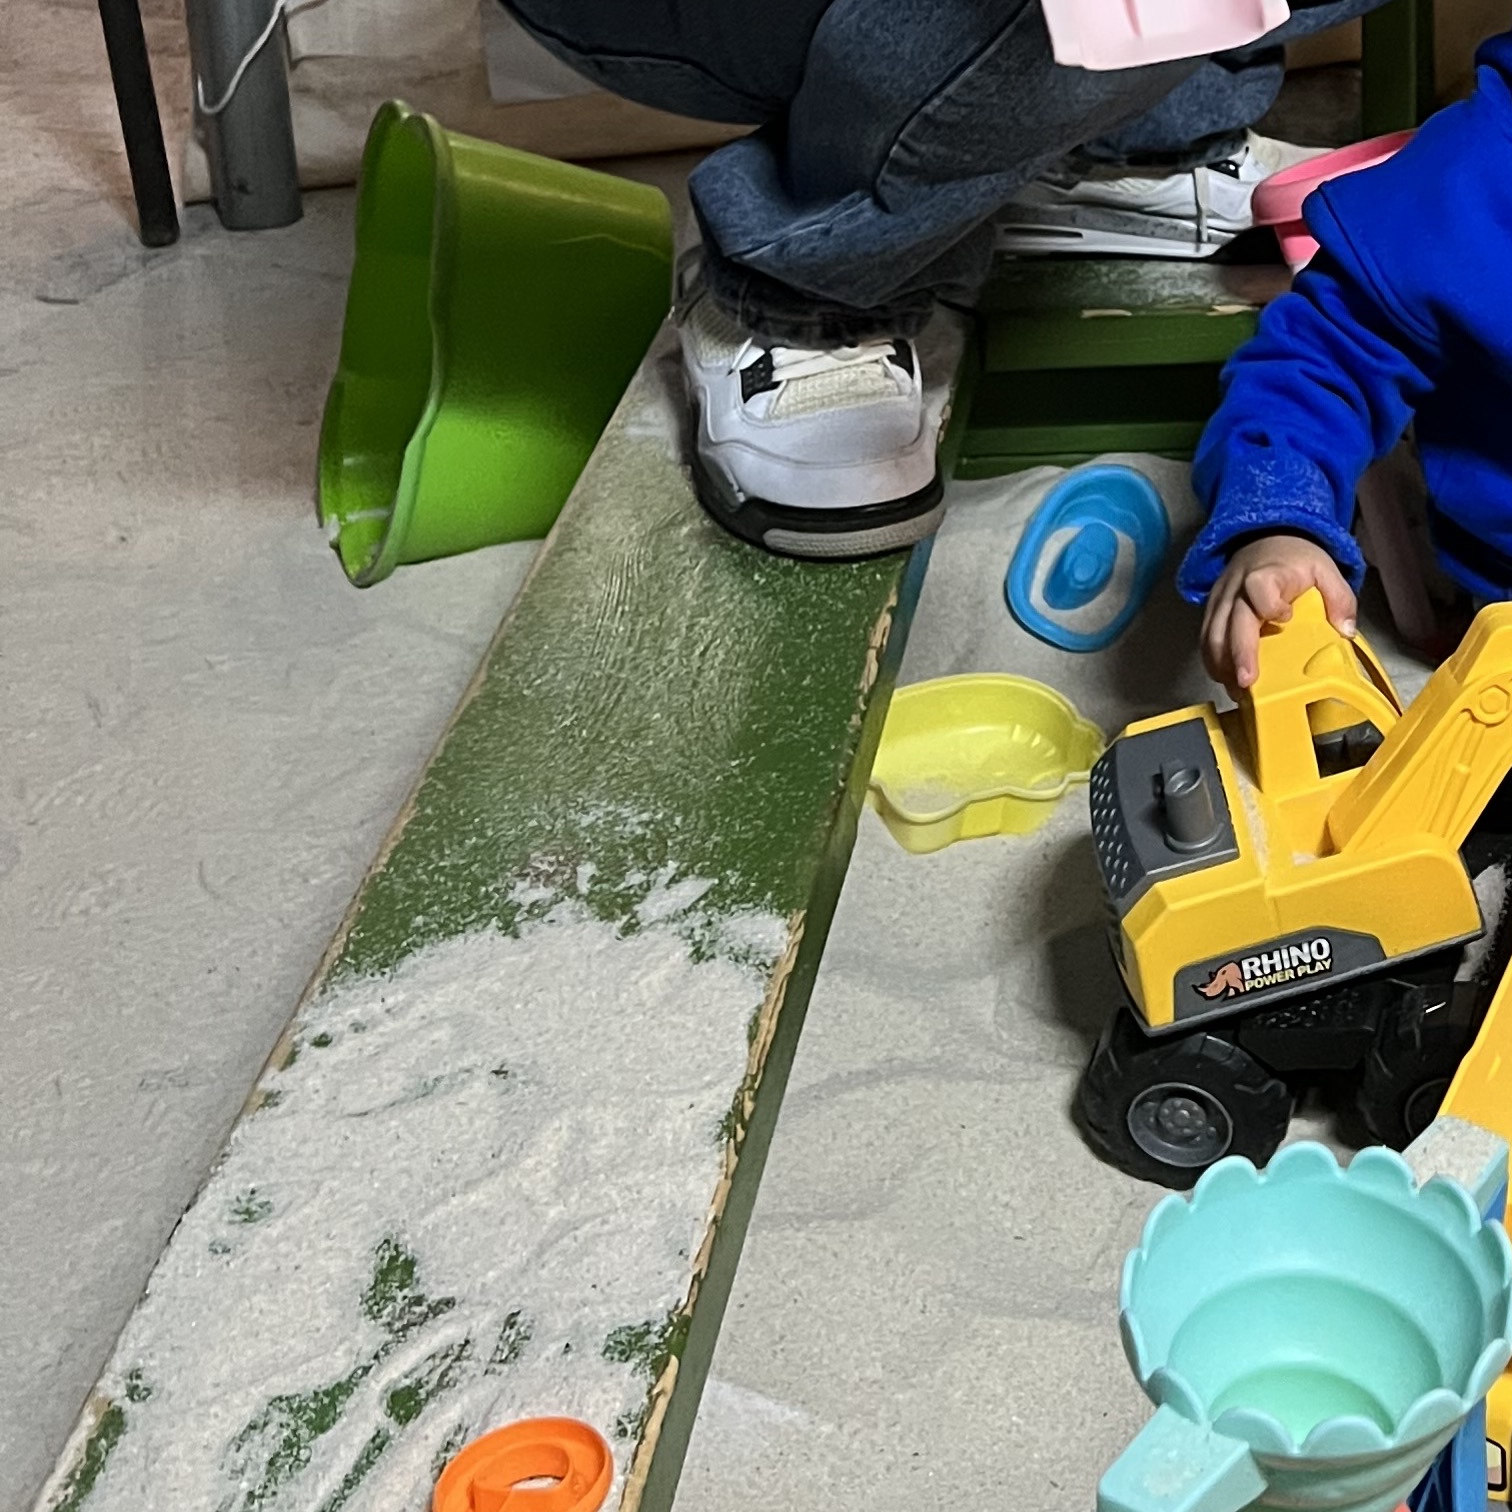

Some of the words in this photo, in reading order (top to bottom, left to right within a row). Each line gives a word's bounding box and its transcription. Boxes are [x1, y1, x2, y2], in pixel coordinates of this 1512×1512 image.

[1241, 938, 1331, 980] RHINO
[1245, 969, 1295, 991] POWER
[1298, 958, 1332, 977] PLAY
